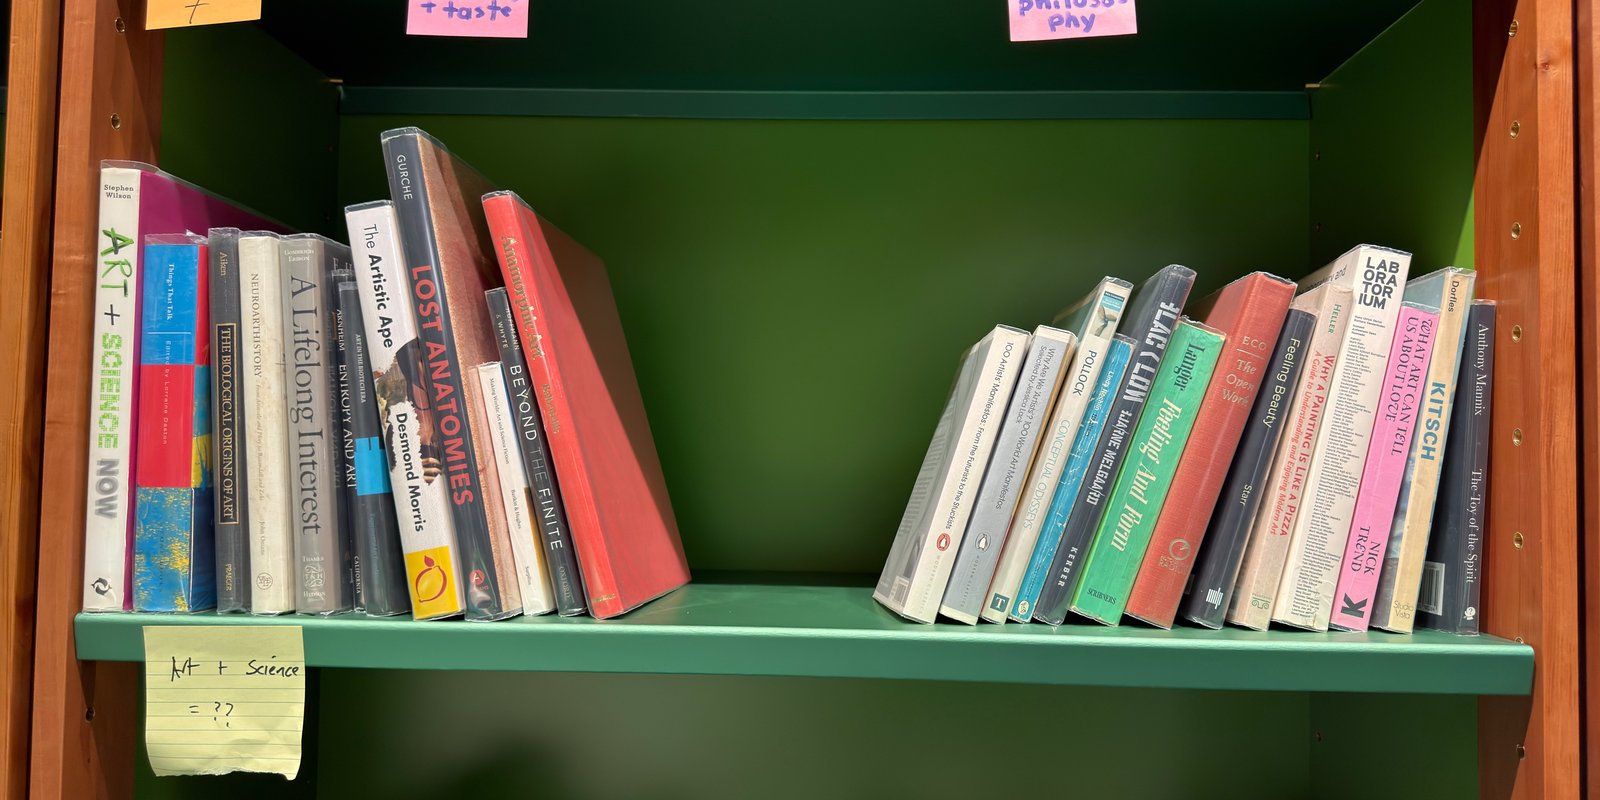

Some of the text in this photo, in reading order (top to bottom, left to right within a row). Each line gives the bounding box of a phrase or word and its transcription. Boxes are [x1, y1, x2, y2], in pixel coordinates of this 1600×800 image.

[443, 0, 513, 21] taste
[1048, 13, 1096, 33] phy
[104, 184, 134, 192] Stephen
[396, 154, 412, 200] GURCHE
[106, 192, 132, 200] Wilson
[166, 263, 174, 286] Things
[218, 251, 228, 275] Aiken
[1366, 256, 1400, 274] LAB
[363, 223, 392, 348] The Artistic Ape
[1362, 281, 1394, 298] TOR
[1364, 270, 1398, 287] ORA
[501, 236, 545, 359] Anamorphic Art
[1358, 294, 1386, 310] IUM
[1447, 280, 1459, 312] Dorfles
[250, 273, 261, 378] NEUROARTHISTORY
[336, 309, 345, 350] ARNHEIM
[1327, 303, 1341, 333] HELLER
[497, 321, 508, 348] WHYTE
[1242, 336, 1266, 350] ECO
[1039, 364, 1049, 377] Are
[1043, 348, 1055, 364] Why
[1173, 343, 1205, 391] Langer
[1237, 360, 1256, 374] The
[1309, 358, 1320, 380] Guide
[1319, 355, 1335, 381] WHY
[1384, 316, 1418, 422] US ABOUT LOVE
[1473, 323, 1489, 416] Anthony Mannix
[94, 227, 133, 520] ART + SCIENCE NOW
[163, 369, 170, 377] by
[412, 264, 473, 504] LOST ANATOMIES
[1015, 345, 1047, 424] Selected by Jessica Lack
[1035, 378, 1045, 390] We
[1072, 349, 1097, 395] POLLOCK
[1122, 362, 1154, 403] LOW
[1226, 374, 1254, 391] Open
[1262, 337, 1300, 428] Feeling Beauty
[1306, 381, 1314, 389] to
[1390, 318, 1432, 455] WHAT ART CAN TELL
[286, 275, 326, 535] A Lifelong Interest
[1222, 388, 1249, 407] Work
[220, 327, 234, 519] THE BIOLOGICAL ORIGINS OF ART
[1020, 420, 1031, 436] 100
[1290, 390, 1312, 443] Understanding
[1302, 394, 1324, 448] PAINTING
[1420, 382, 1445, 460] KITSCH
[343, 428, 353, 459] AND
[945, 342, 1013, 529] 100 Artists' Manifestos: From the Futurists to the Stuckists
[1013, 436, 1026, 458] World
[1040, 419, 1070, 479] CONCEPTUAL
[395, 412, 426, 531] Desmond Morris
[509, 364, 562, 550] BEYOND THE FINITE
[1009, 456, 1018, 469] Art
[1298, 452, 1309, 463] IS
[346, 463, 356, 489] ART
[995, 469, 1015, 509] Manifestos
[1086, 448, 1116, 505] MELGAARD
[1110, 397, 1182, 551] Feeling And Form
[1278, 460, 1294, 492] Enjoying
[1291, 466, 1305, 490] LIKE
[1022, 482, 1047, 529] ODYSSEYS
[1239, 484, 1252, 506] Starr
[1273, 492, 1286, 521] Modern
[1269, 522, 1278, 535] Art
[1279, 504, 1296, 535] PIZZA
[1463, 468, 1482, 583] The Toy of the Spirit
[1351, 526, 1370, 571] TREND
[1363, 541, 1380, 575] NICK
[1057, 546, 1078, 586] KERBER
[559, 565, 571, 598] OXFORD
[1088, 588, 1116, 605] SCRIBNERS
[1393, 600, 1413, 612] Studio
[1394, 609, 1410, 620] Vista
[171, 656, 300, 682] Art + Science
[214, 702, 234, 728] ??
